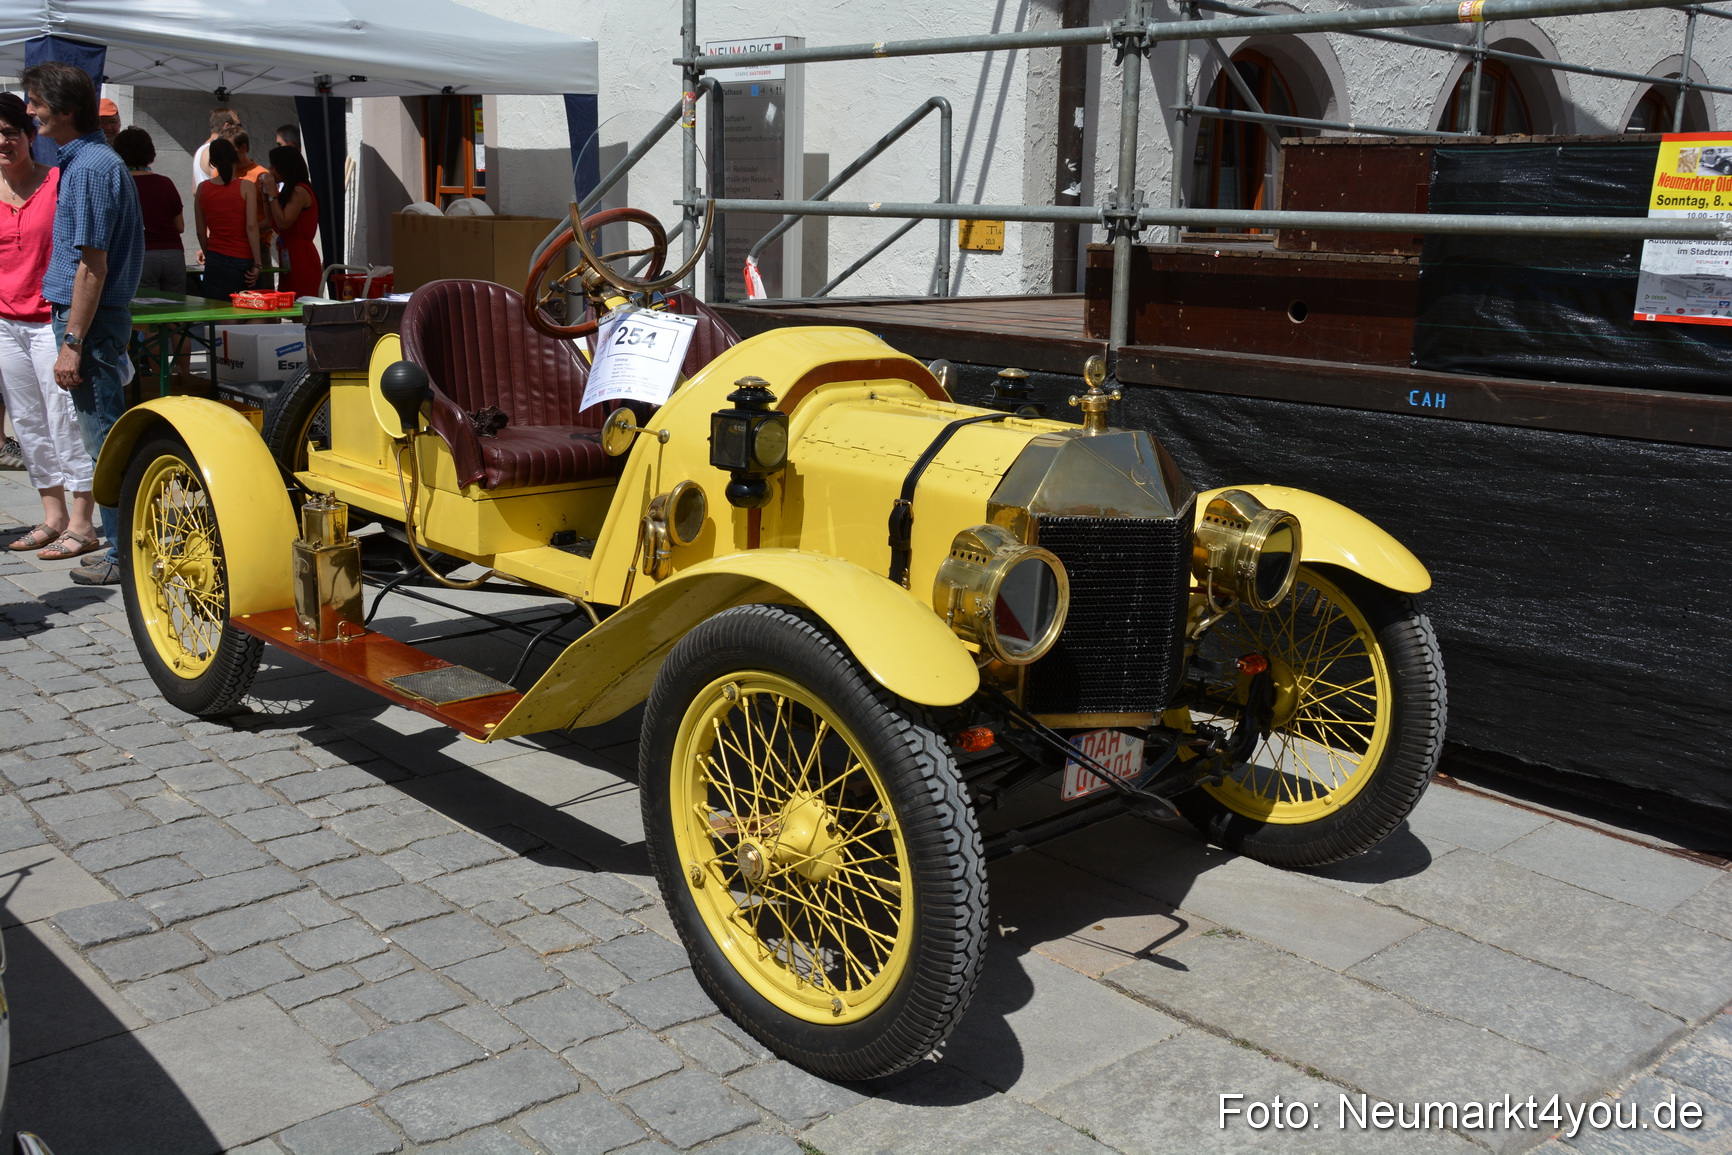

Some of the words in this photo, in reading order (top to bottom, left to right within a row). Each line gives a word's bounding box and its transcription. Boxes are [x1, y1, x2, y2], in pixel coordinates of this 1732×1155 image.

[1657, 171, 1716, 193] Neumarkter
[1656, 194, 1709, 209] Sonntag,
[1713, 195, 1724, 206] 8.
[1677, 247, 1688, 255] im
[614, 326, 657, 349] 254
[1409, 390, 1446, 408] CAH
